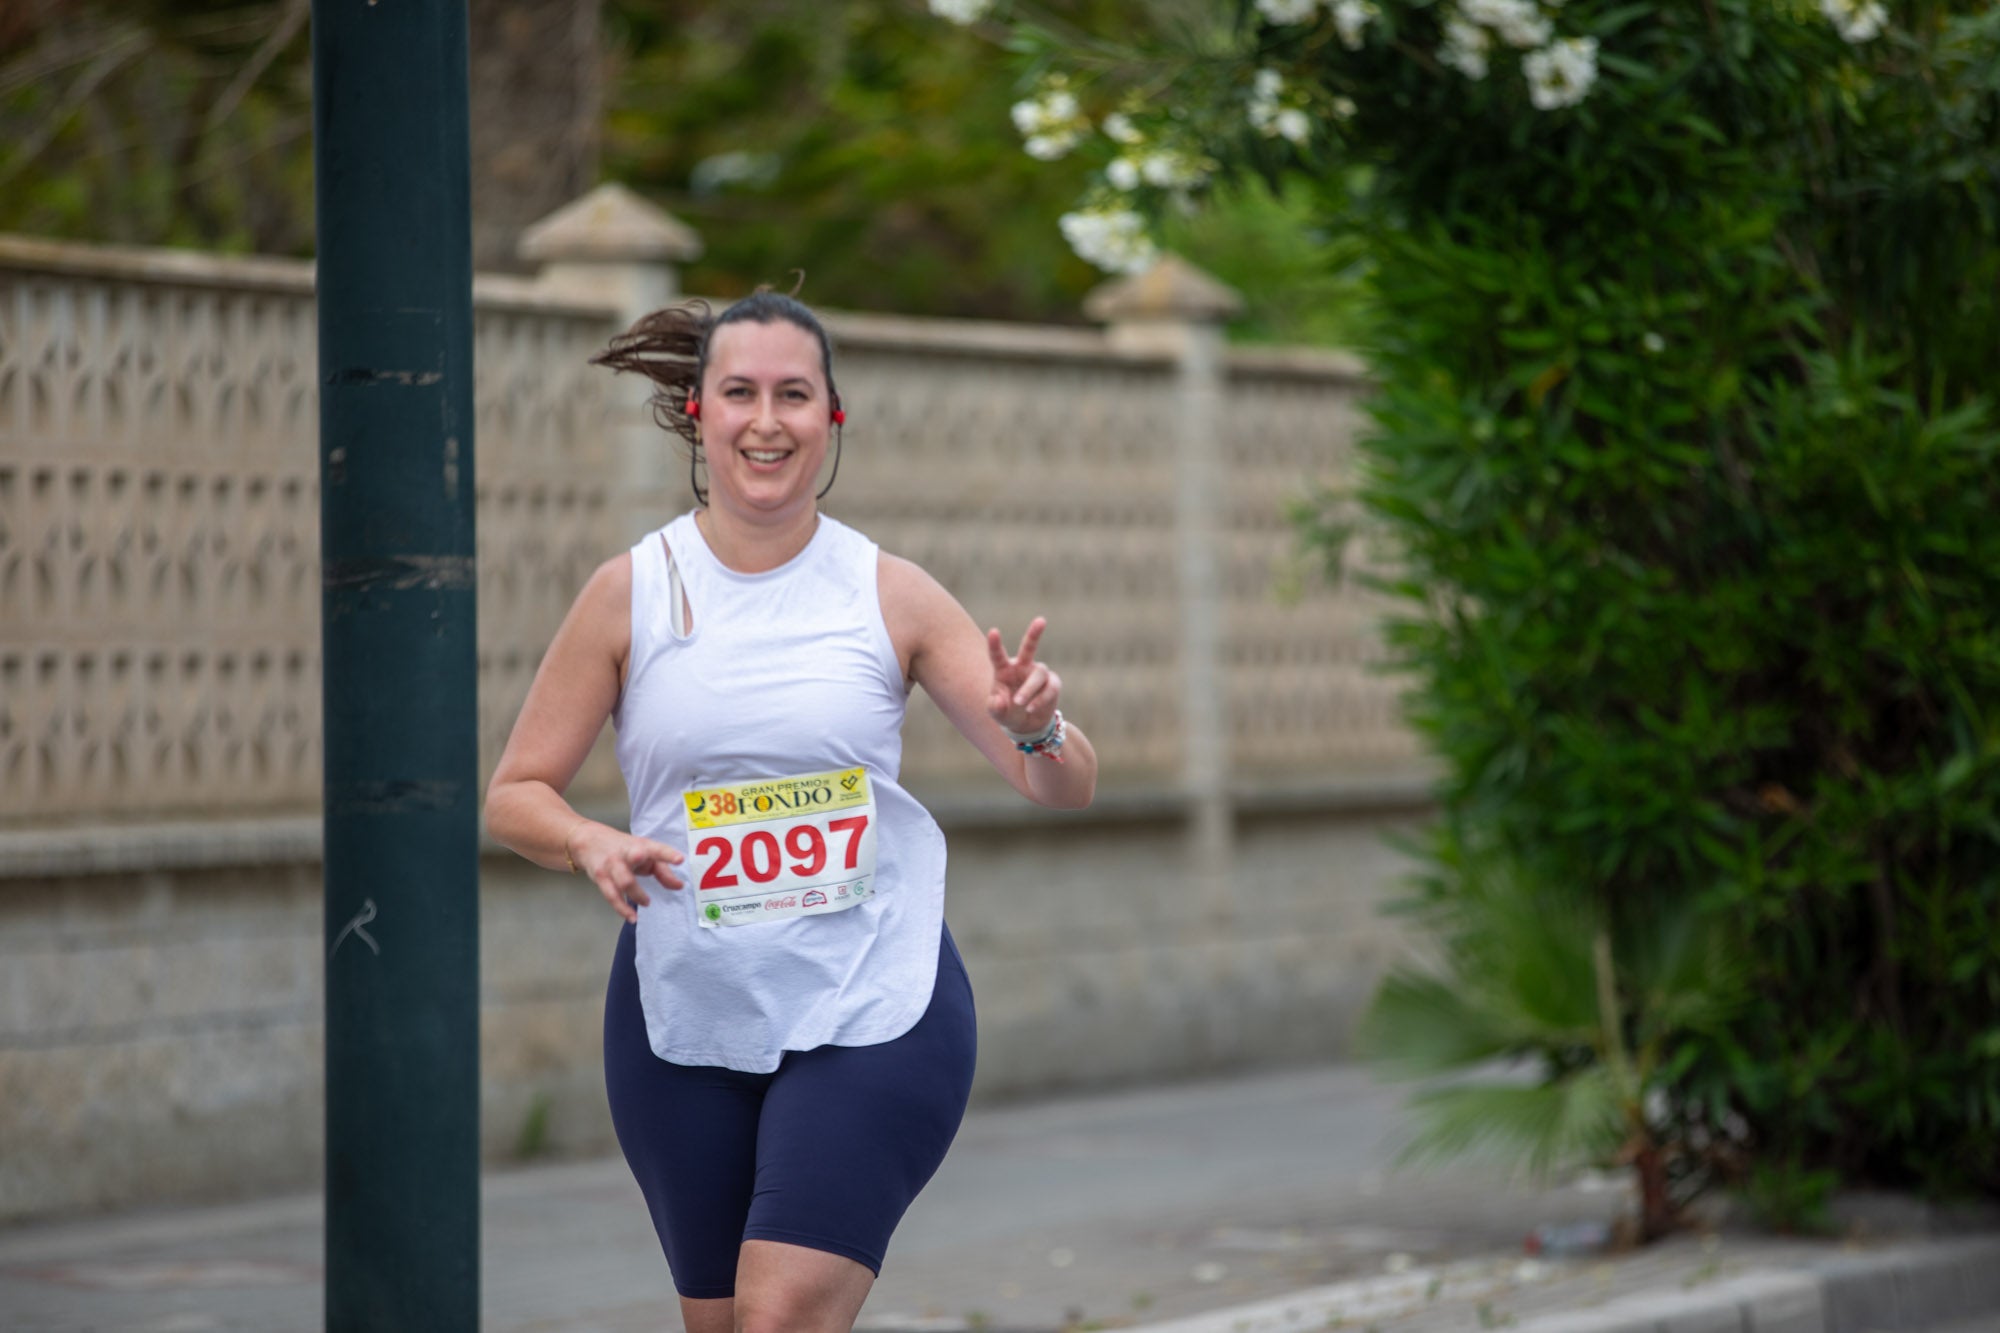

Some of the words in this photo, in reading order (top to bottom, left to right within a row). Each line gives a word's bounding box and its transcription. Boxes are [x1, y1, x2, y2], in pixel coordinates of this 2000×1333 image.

[741, 785, 775, 797] GRAN
[777, 779, 822, 793] PREMIO
[709, 792, 737, 816] 38
[738, 787, 832, 815] FONDO
[695, 815, 869, 890] 2097
[722, 902, 762, 913] Cruzcampo
